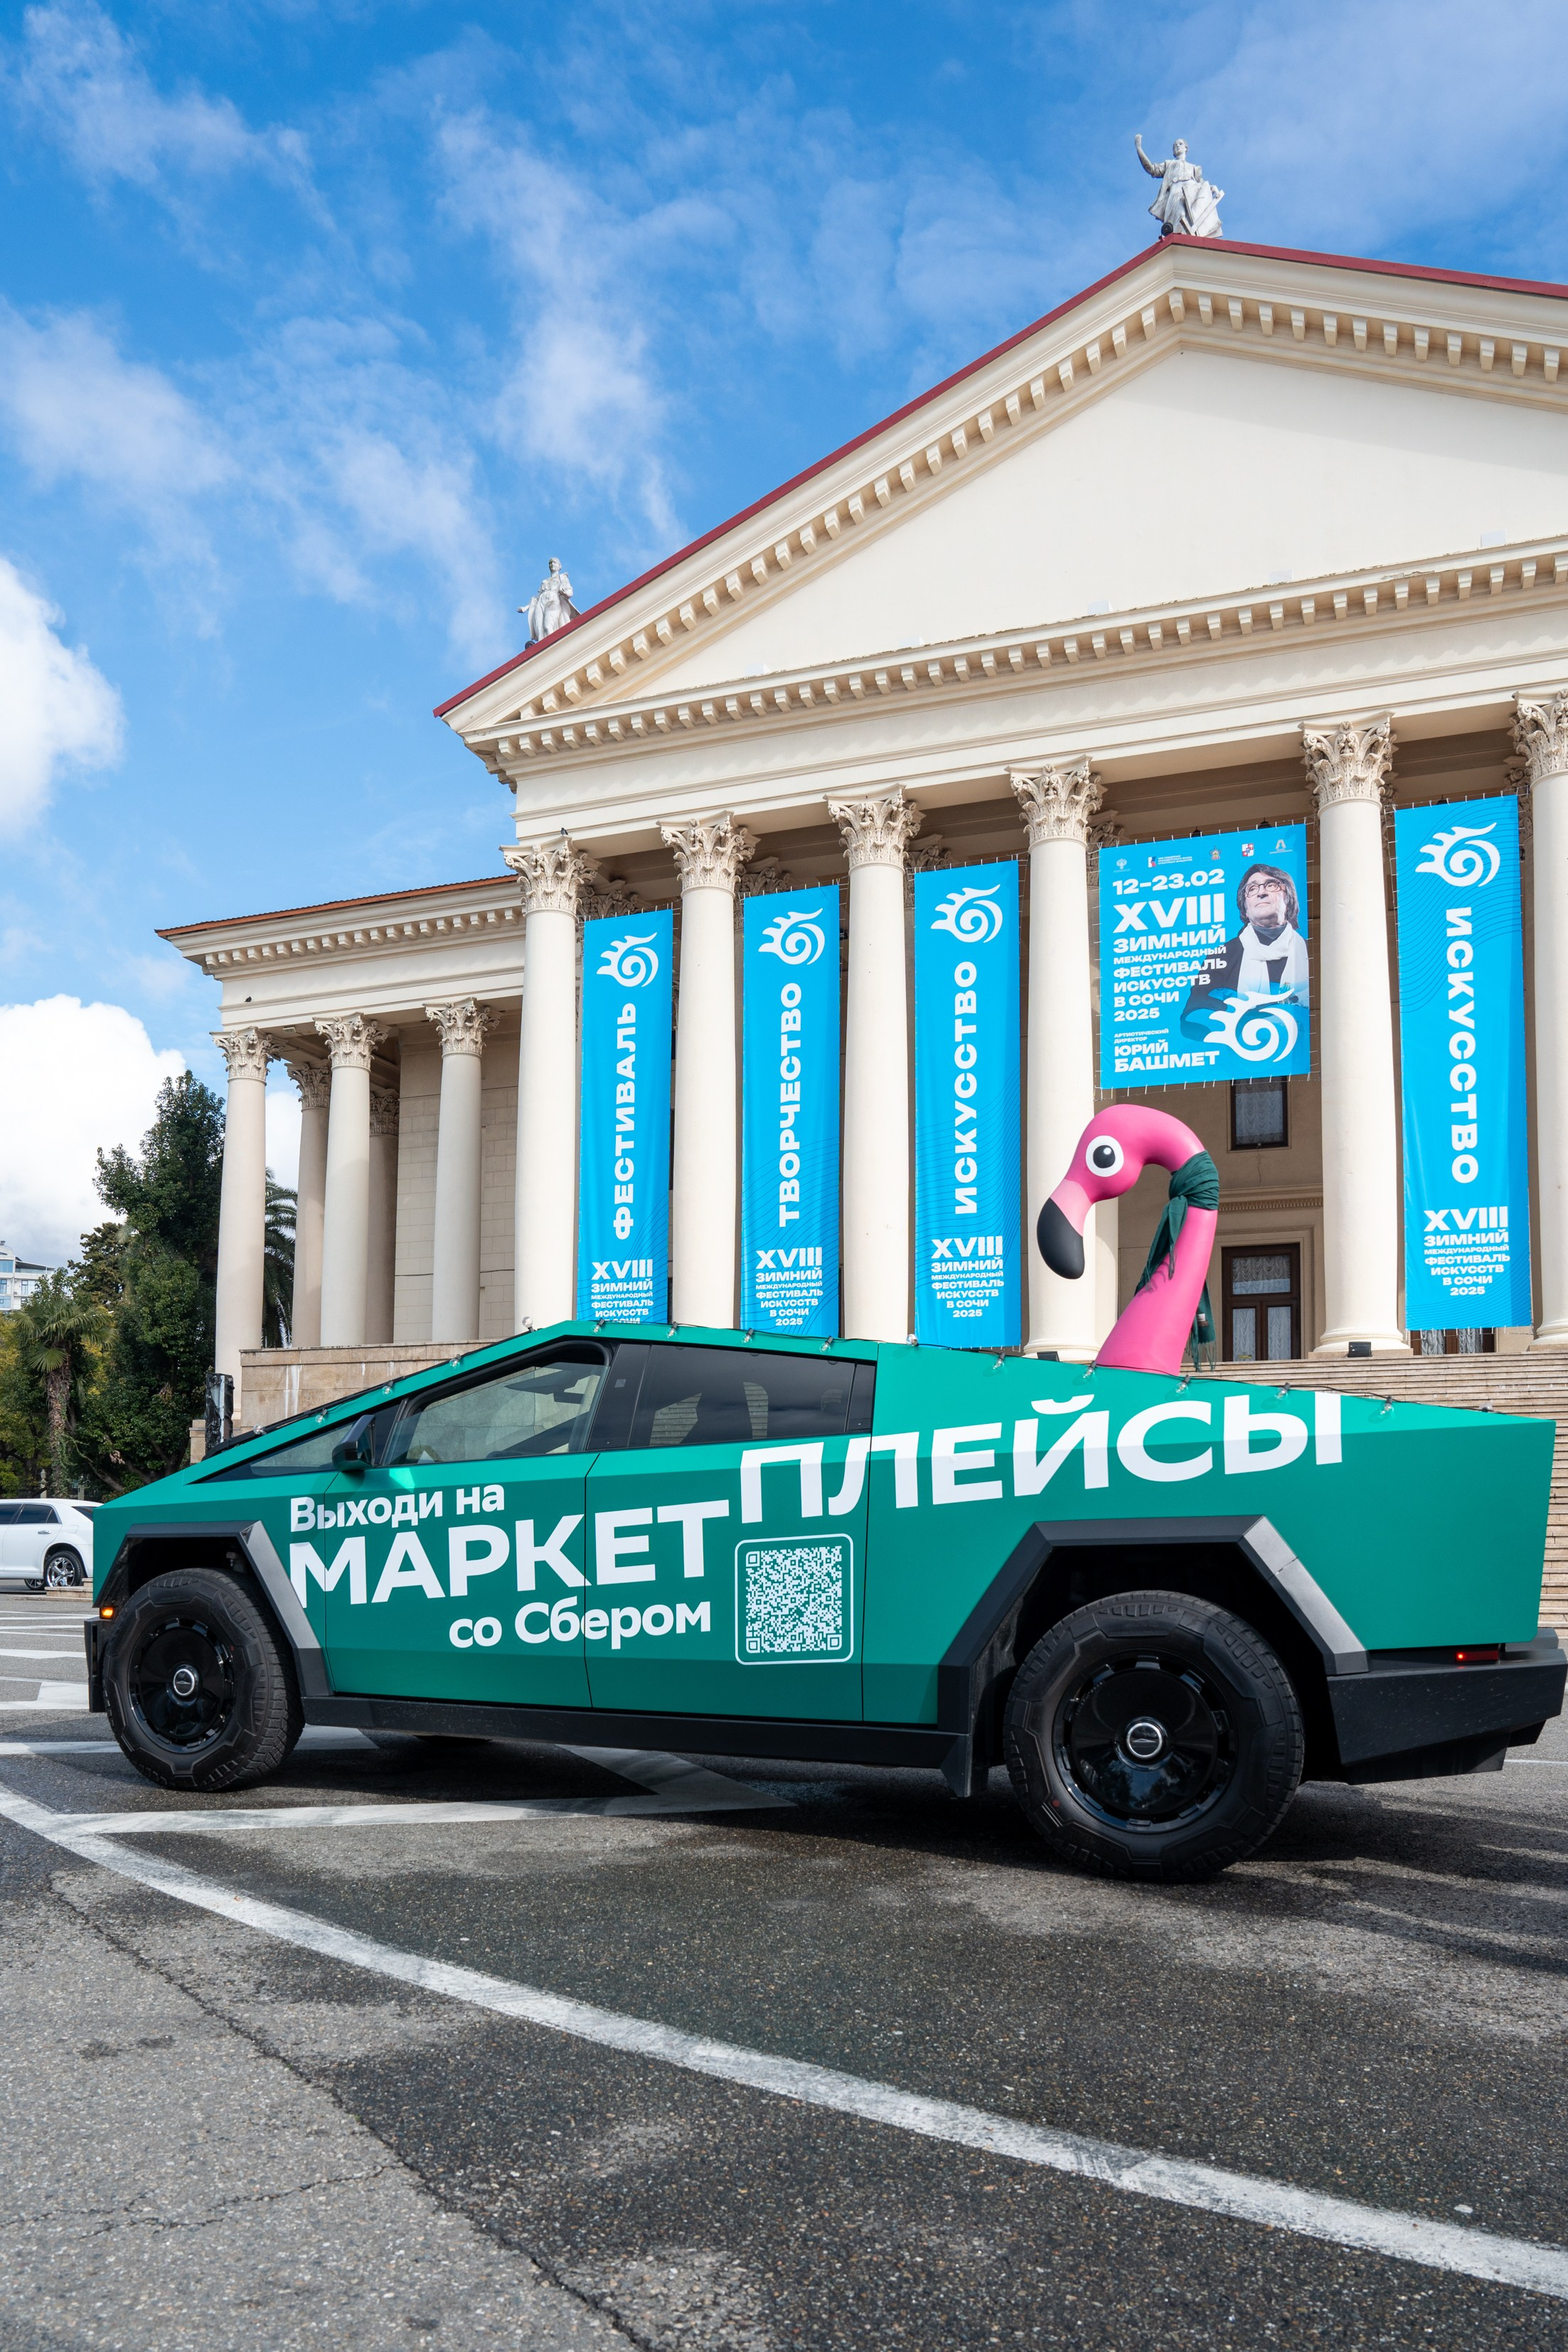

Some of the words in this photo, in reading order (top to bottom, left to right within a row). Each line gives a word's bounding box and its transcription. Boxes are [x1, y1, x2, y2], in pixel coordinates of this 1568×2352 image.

[1113, 869, 1225, 895] 12-23.02
[1113, 893, 1225, 933] XVIII
[1113, 925, 1226, 953] ЗИМНИЙ
[1114, 945, 1227, 964] МЕЖДУНАРОДНЫЙ
[1114, 958, 1227, 979] ФЕСТИВАЛЬ
[1114, 974, 1211, 993] ИСКУССТВ
[1114, 997, 1126, 1008] В
[1129, 991, 1179, 1006] СОЧИ
[1114, 1008, 1159, 1022] 2025
[1114, 1028, 1168, 1038] АРТИСТИЧЕСКИЙ
[1114, 1039, 1168, 1056] ЮРИЙ
[1446, 907, 1478, 1183] ИСКУССТВО
[1114, 1050, 1220, 1073] БАШМЕТ
[954, 961, 978, 1215] ИСКУССТВО
[779, 982, 801, 1228] ТВОРЧЕСТВО
[613, 1003, 636, 1240] ФЕСТИВАЛЬ
[1424, 1206, 1508, 1231] XVIII
[1424, 1228, 1509, 1246] ЗИМНИЙ
[931, 1235, 1003, 1259] XVIII
[1424, 1244, 1510, 1255] МЕЖДУНАРОДНЫЙ
[755, 1247, 823, 1270] XVIII
[931, 1257, 1003, 1272] ЗИМНИЙ
[1424, 1253, 1510, 1265] ФЕСТИВАЛЬ
[591, 1259, 653, 1280] XVIII
[755, 1267, 823, 1282] ЗИМНИЙ
[931, 1270, 1003, 1280] МЕЖДУНАРОДНЫЙ
[1431, 1264, 1504, 1275] ИСКУССТВ
[591, 1278, 653, 1293] ЗИМНИЙ
[755, 1281, 823, 1289] МЕЖДУНАРОДНЫЙ
[932, 1279, 1005, 1289] ФЕСТИВАЛЬ
[1454, 1275, 1493, 1284] СОЧИ
[591, 1291, 653, 1300] МЕЖДУНАРОДНЫЙ
[755, 1289, 823, 1299] ФЕСТИВАЛЬ
[937, 1289, 999, 1299] ИСКУССТВ
[1450, 1286, 1486, 1296] 2025
[591, 1299, 654, 1309] ФЕСТИВАЛЬ
[760, 1298, 818, 1308] ИСКУССТВ
[946, 1300, 954, 1309] В
[956, 1299, 989, 1308] СОЧИ
[595, 1308, 649, 1318] ИСКУССТВ
[779, 1308, 809, 1316] СОЧИ
[952, 1309, 983, 1318] 2025
[290, 1490, 443, 1532] Выходи
[456, 1484, 505, 1515] на
[449, 1616, 502, 1648] со
[515, 1595, 711, 1650] Сбером
